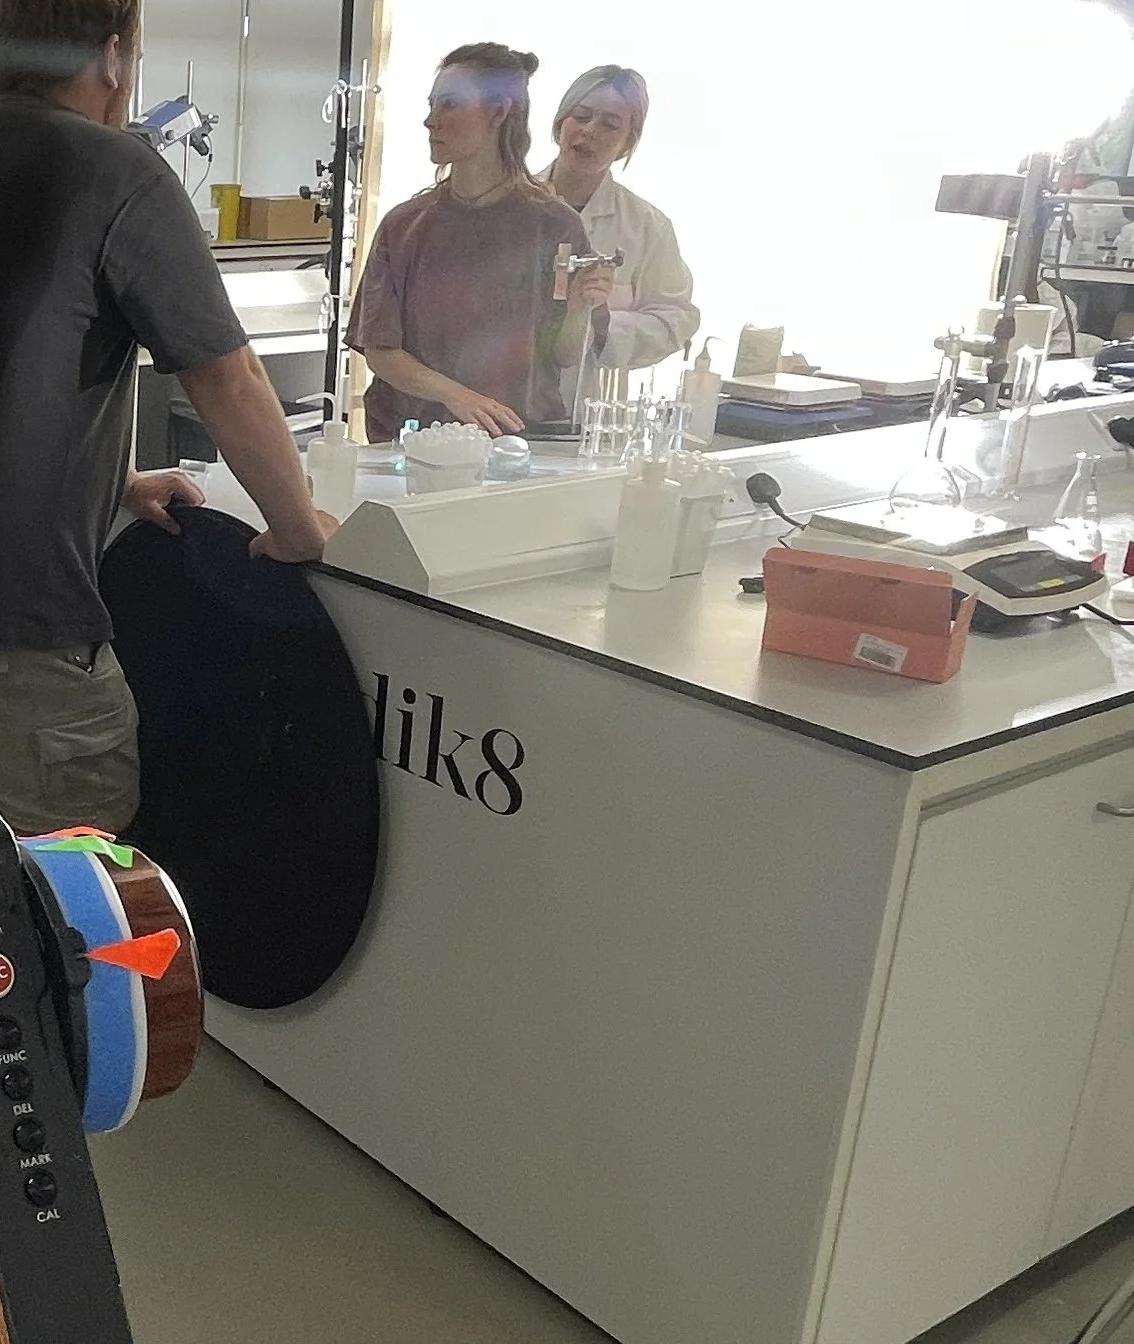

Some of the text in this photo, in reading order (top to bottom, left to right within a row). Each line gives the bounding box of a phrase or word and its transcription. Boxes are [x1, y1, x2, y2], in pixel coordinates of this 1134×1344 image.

[13, 1103, 34, 1116] DEL
[20, 1153, 53, 1169] MARK
[36, 1209, 61, 1223] CAL
